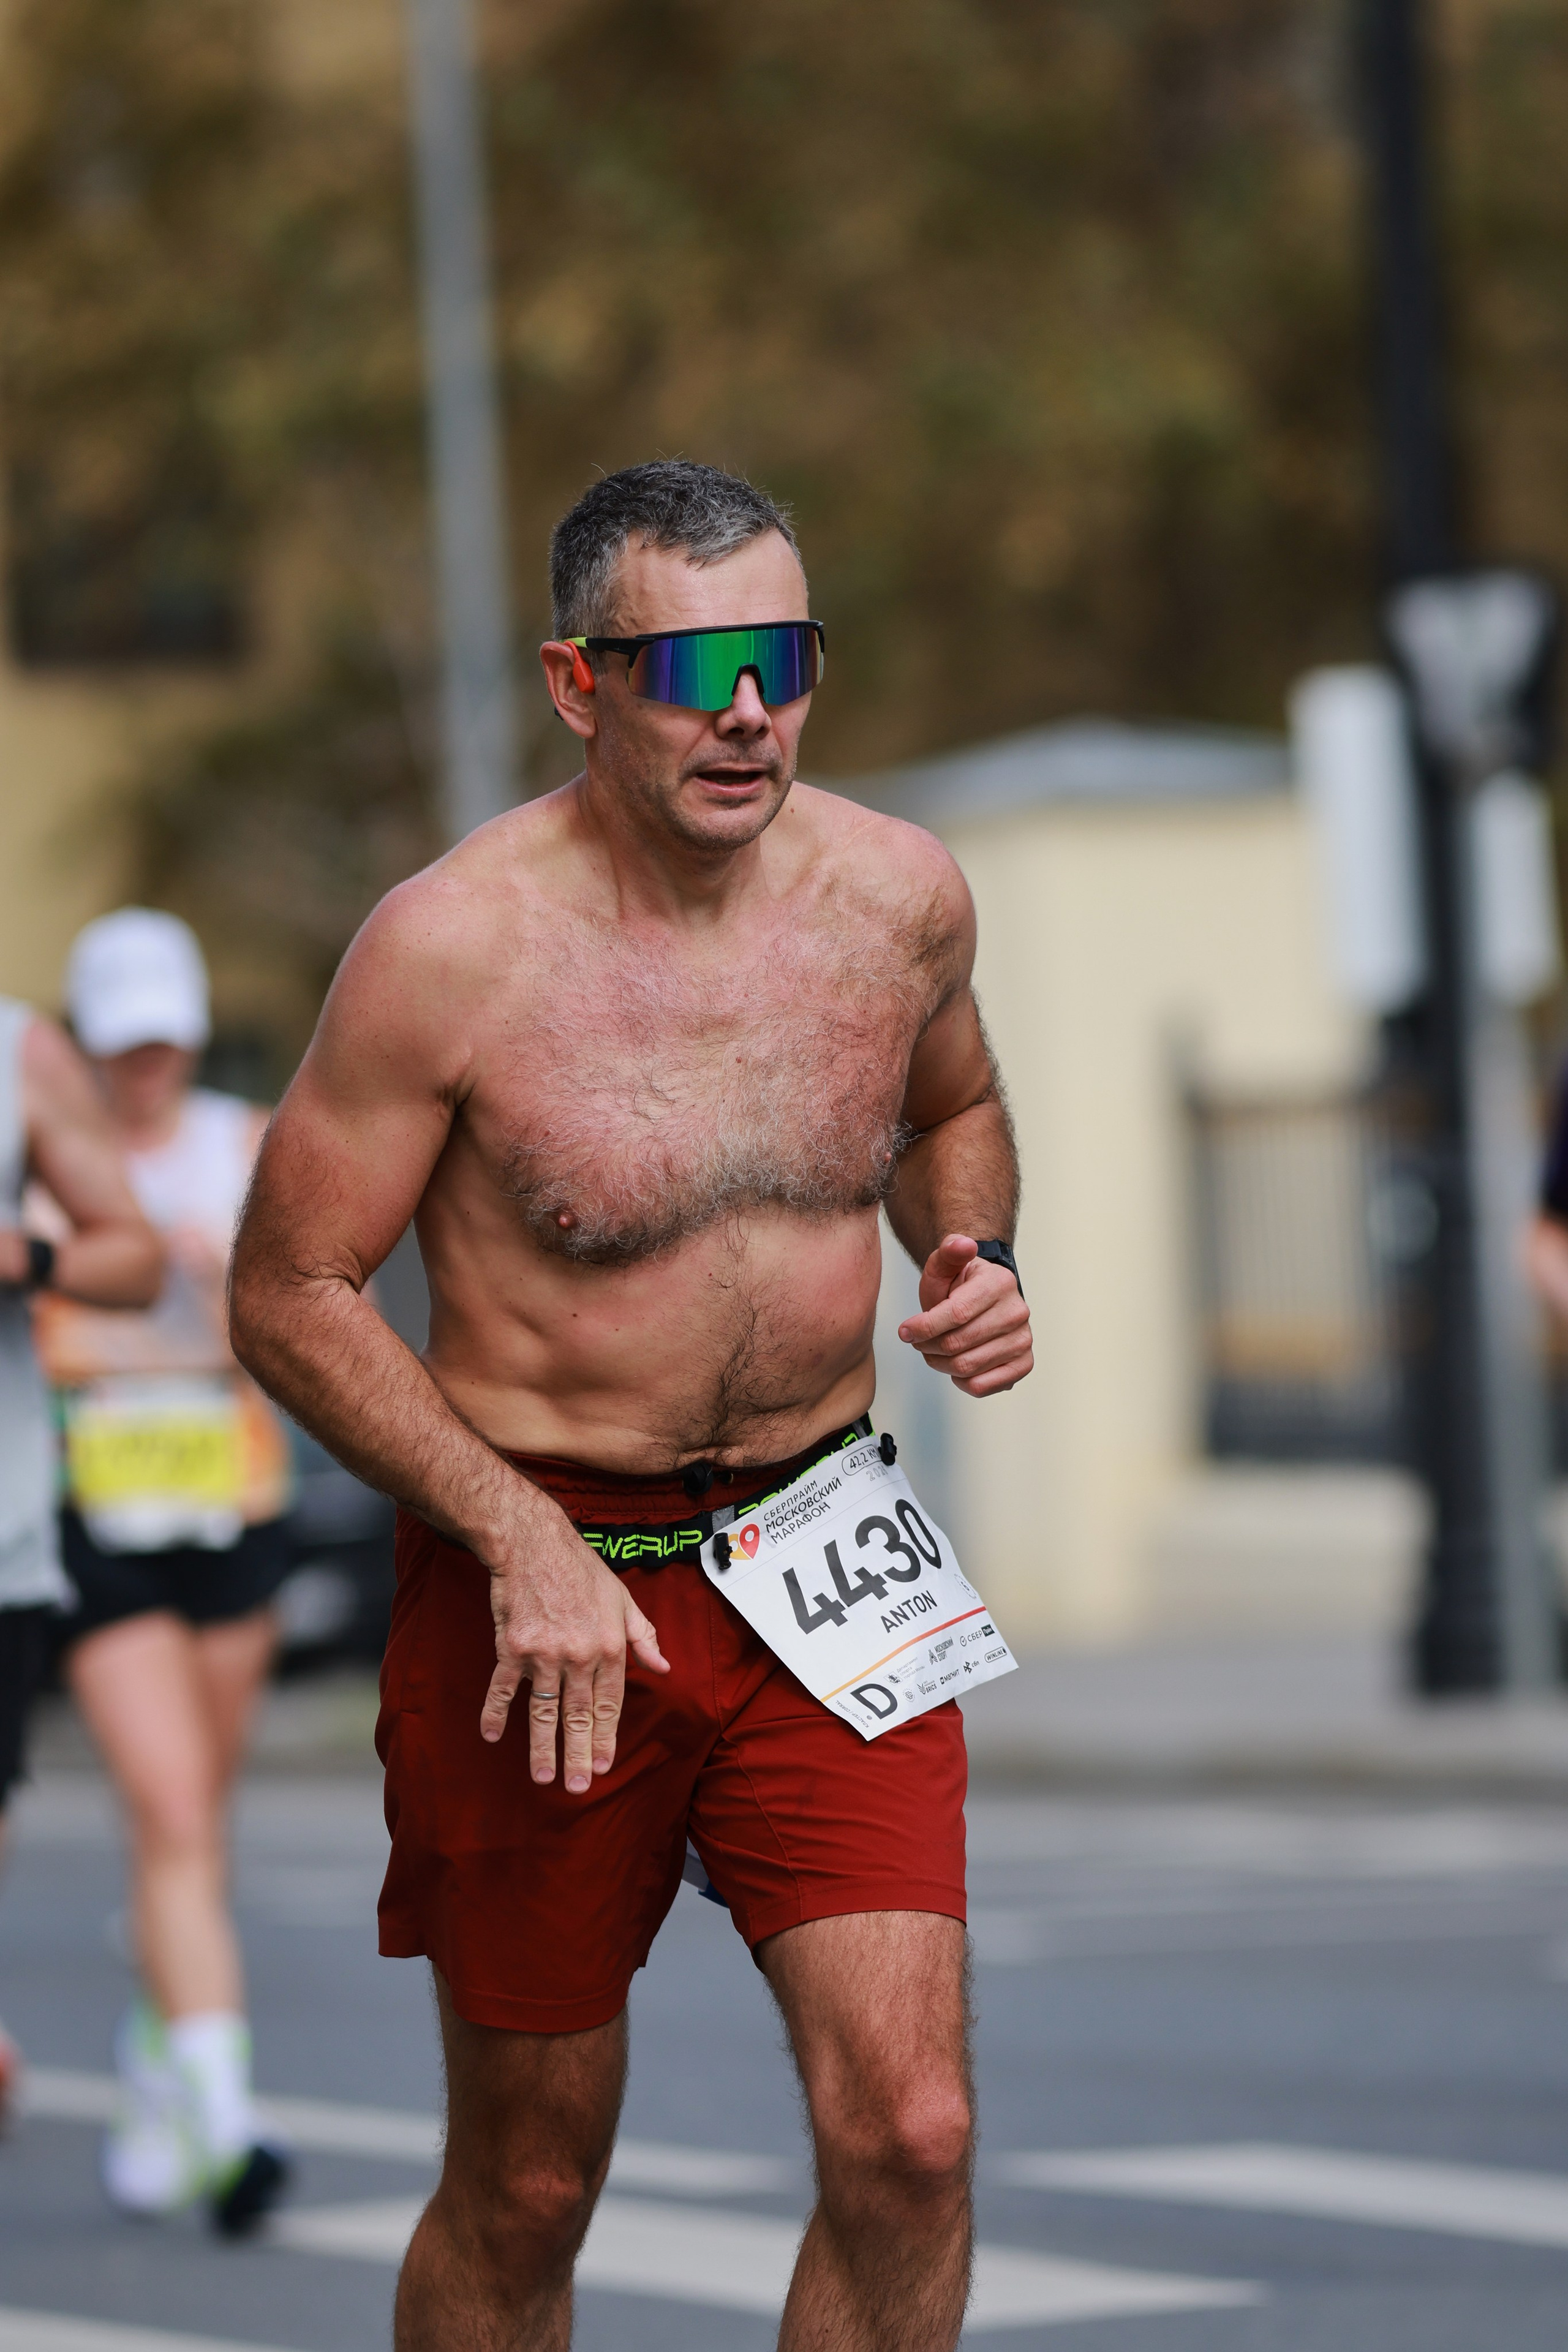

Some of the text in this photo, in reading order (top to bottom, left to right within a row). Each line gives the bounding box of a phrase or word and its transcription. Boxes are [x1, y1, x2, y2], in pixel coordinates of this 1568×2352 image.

[850, 1452, 869, 1469] 42,2
[763, 1480, 818, 1521] СБЕРПРАЙМ
[766, 1476, 842, 1533] МОСКОВСКИЙ
[771, 1501, 831, 1544] МАРАФОН
[782, 1498, 942, 1635] 4430
[880, 1590, 938, 1634] ANTON
[967, 1630, 983, 1642] СБЕР
[986, 1649, 1004, 1661] WINLINE
[850, 1683, 898, 1720] D
[925, 1683, 937, 1693] BRICS
